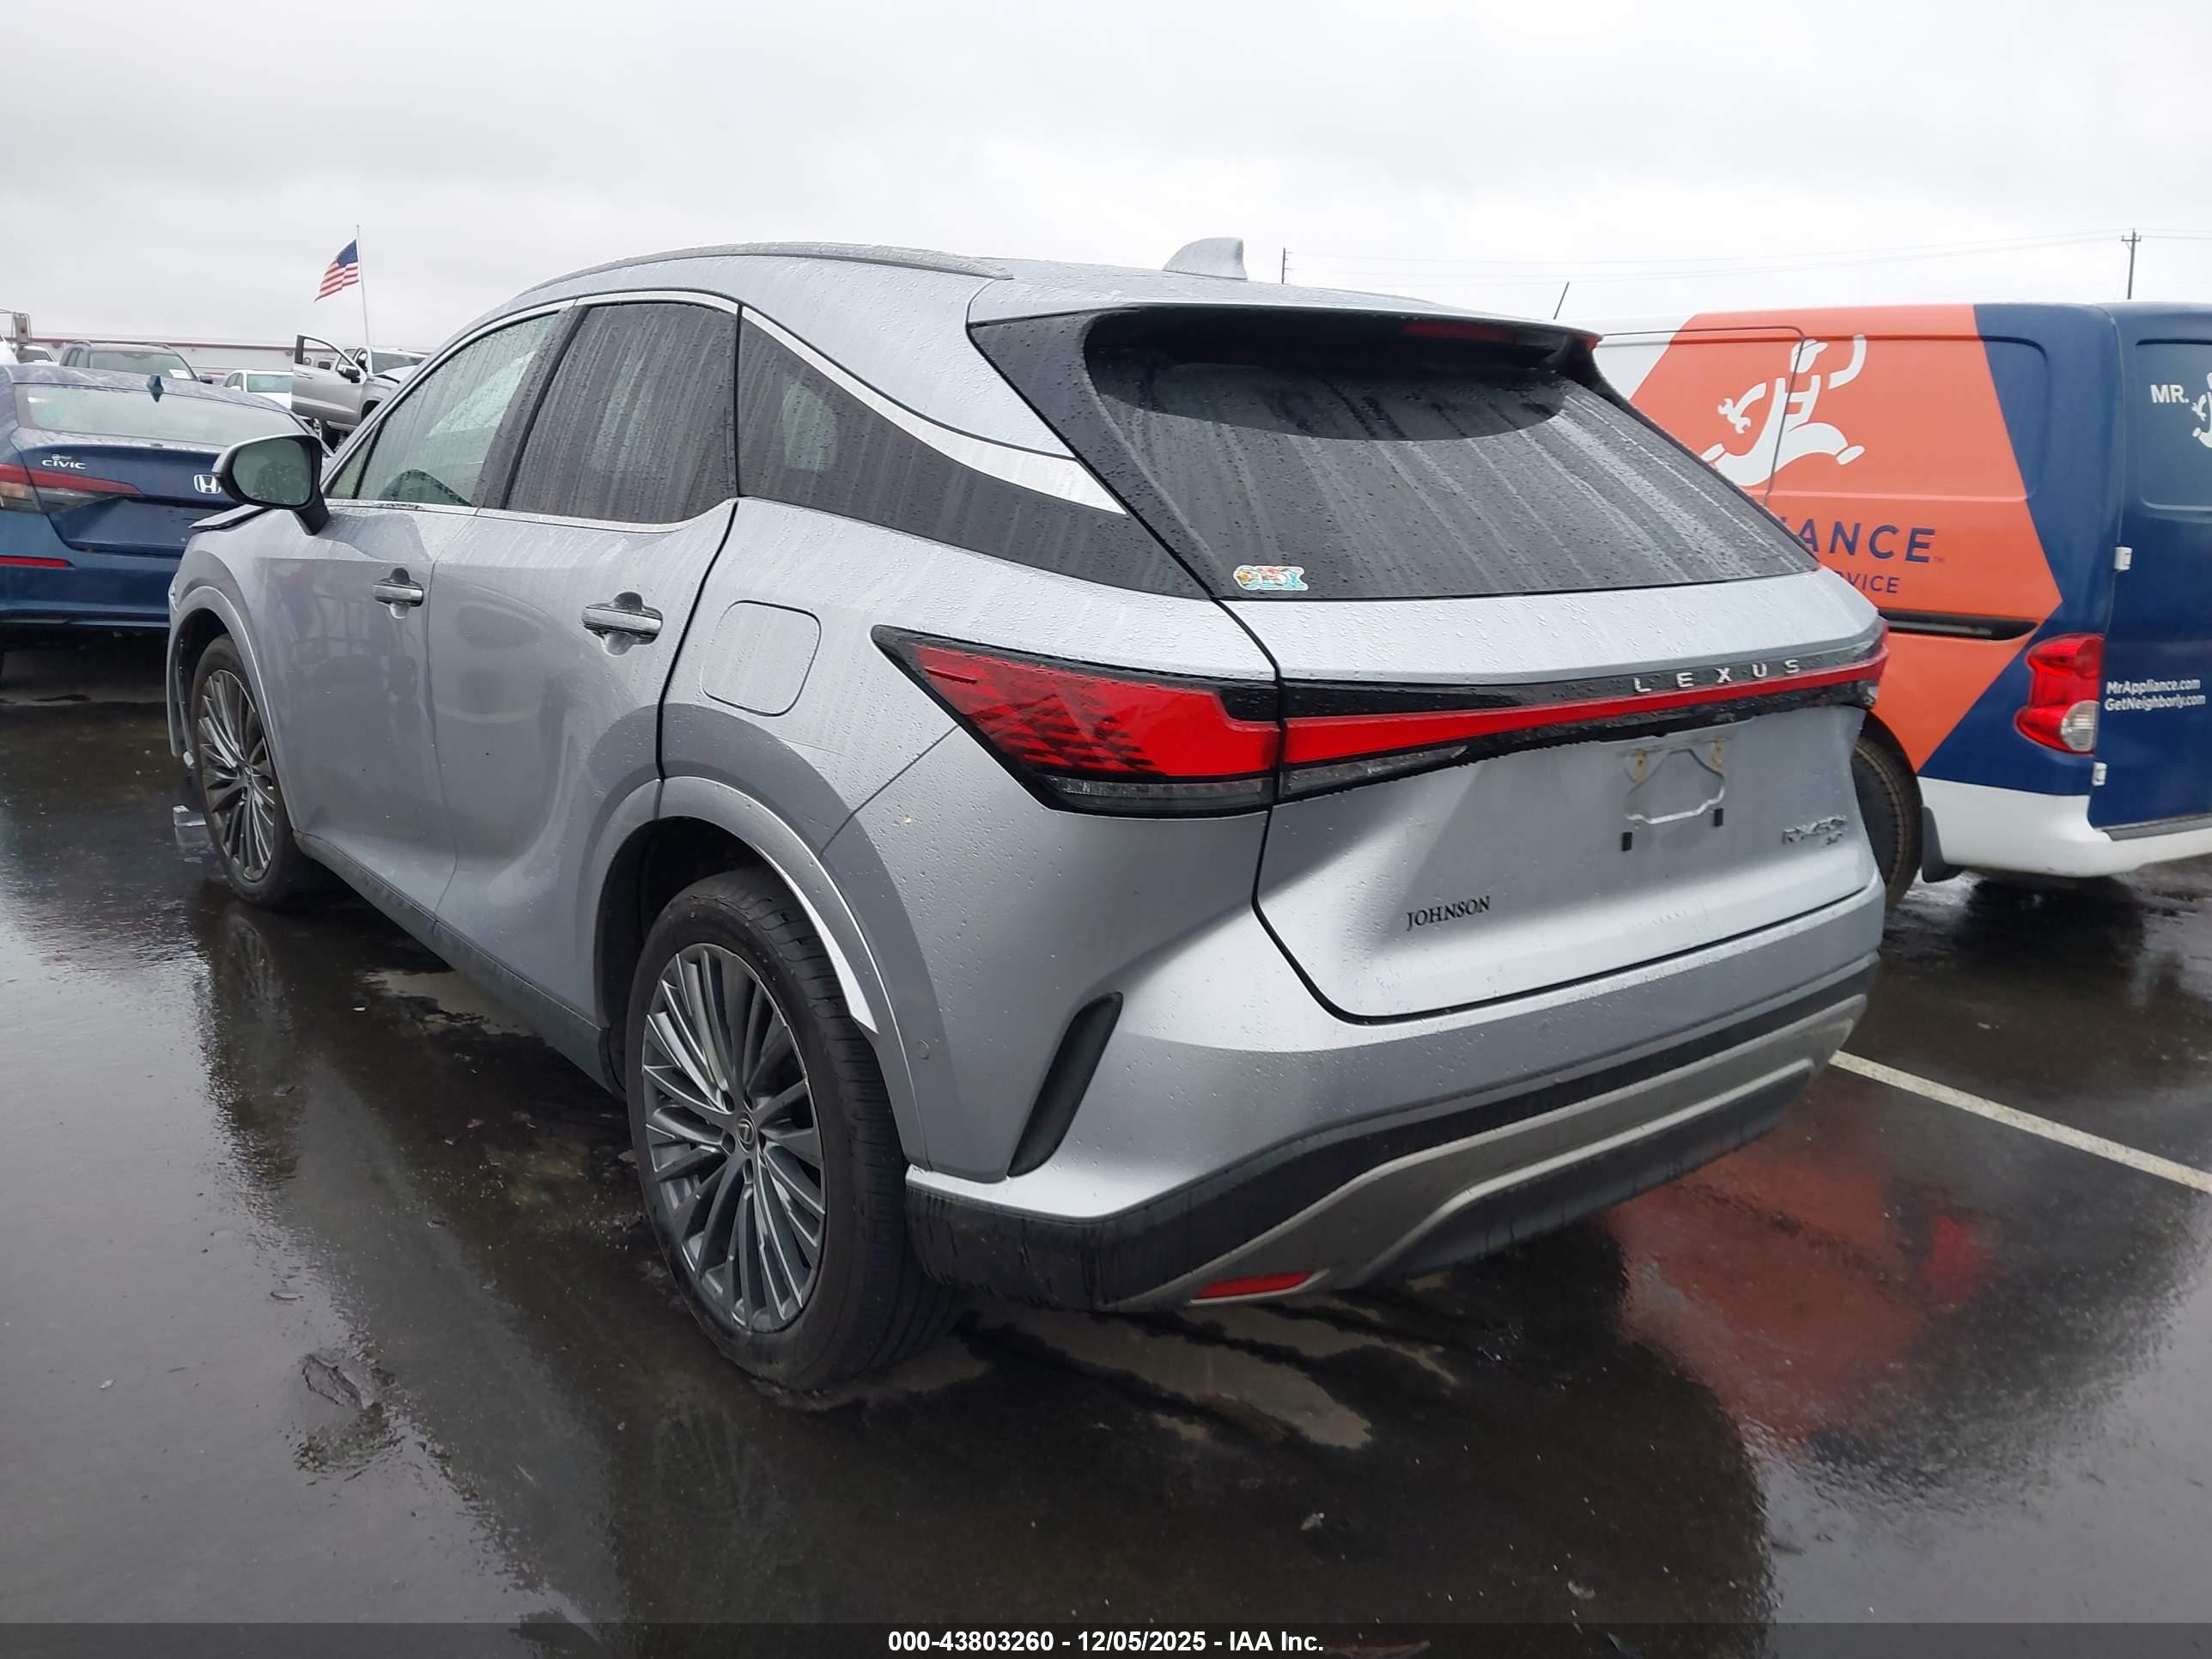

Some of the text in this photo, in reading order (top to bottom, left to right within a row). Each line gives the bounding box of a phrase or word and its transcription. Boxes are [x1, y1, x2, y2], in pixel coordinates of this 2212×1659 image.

[2150, 384, 2190, 404] MR.
[41, 459, 87, 470] CIVIC
[1780, 516, 1936, 563] ANCE
[1633, 659, 1801, 693] LEXUS
[2106, 678, 2201, 696] MrAppliance.com
[2105, 693, 2206, 711] GetNeighborly.com
[1407, 895, 1490, 932] JOHNSON
